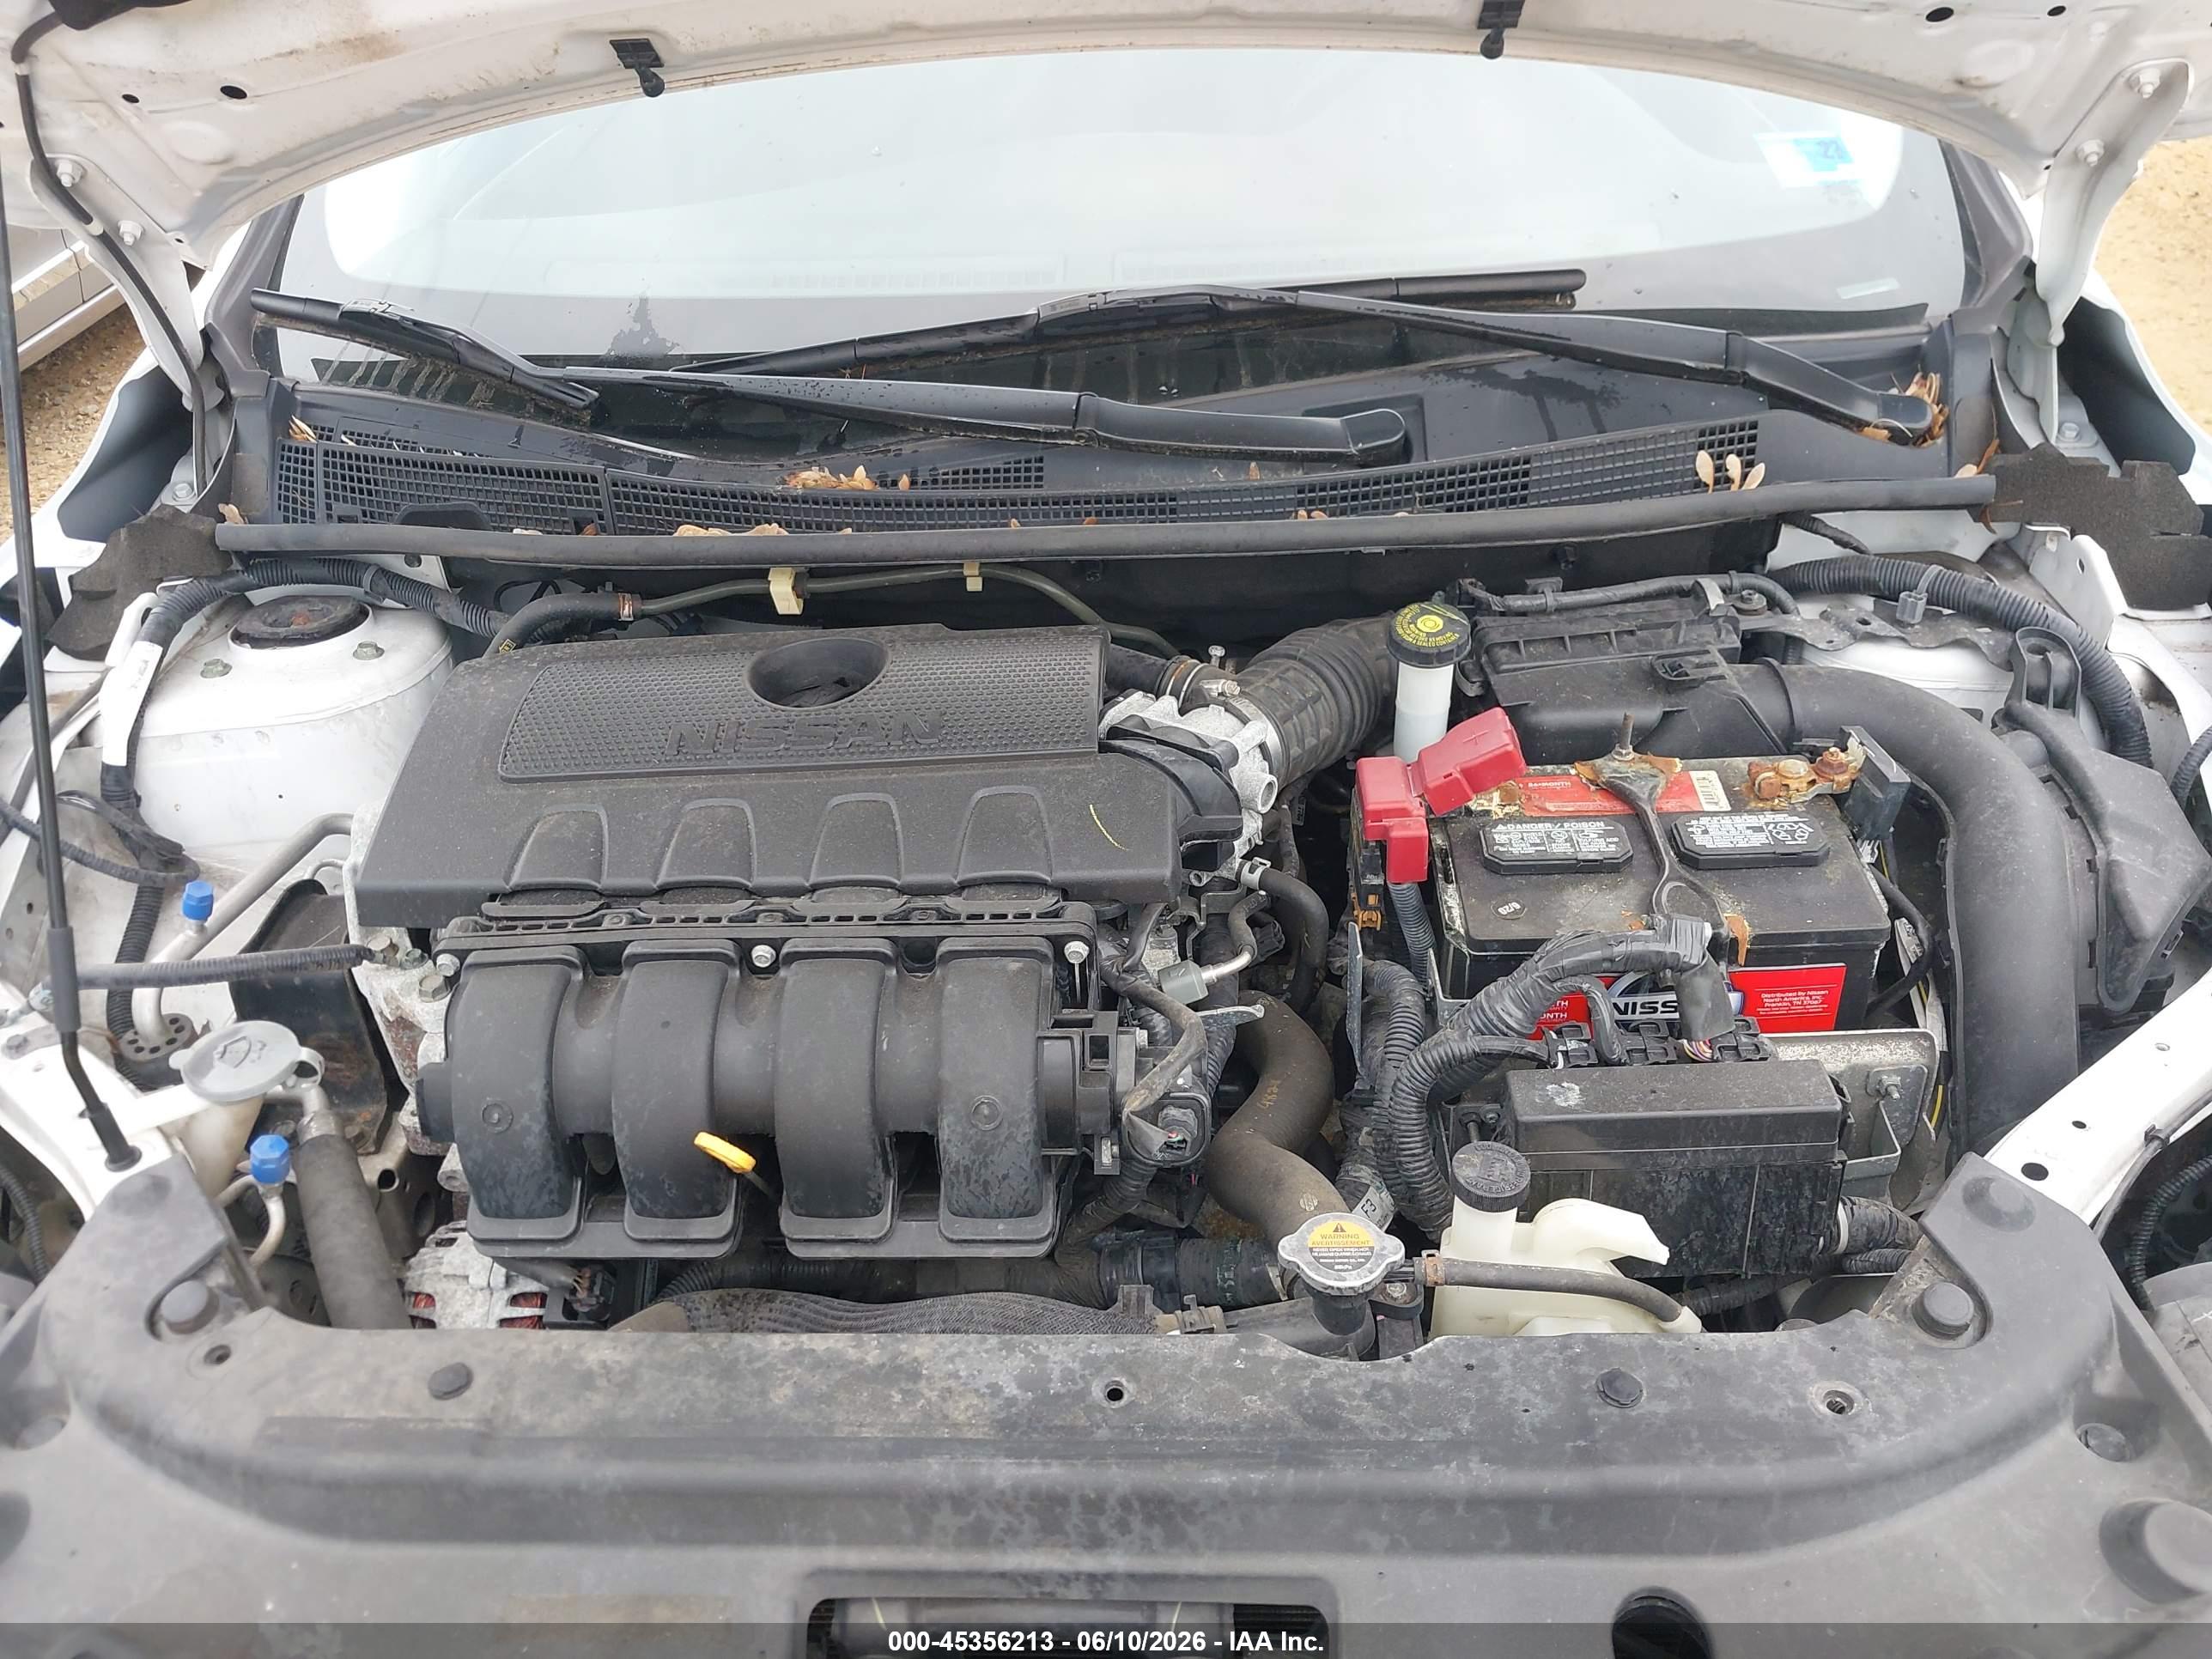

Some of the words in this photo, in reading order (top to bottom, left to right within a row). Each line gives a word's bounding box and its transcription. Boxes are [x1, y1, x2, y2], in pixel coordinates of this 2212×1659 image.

[664, 711, 942, 757] NISSAN
[1498, 902, 1521, 915] 6/20
[1613, 1000, 1680, 1015] NISS
[1361, 1198, 1377, 1218] F3
